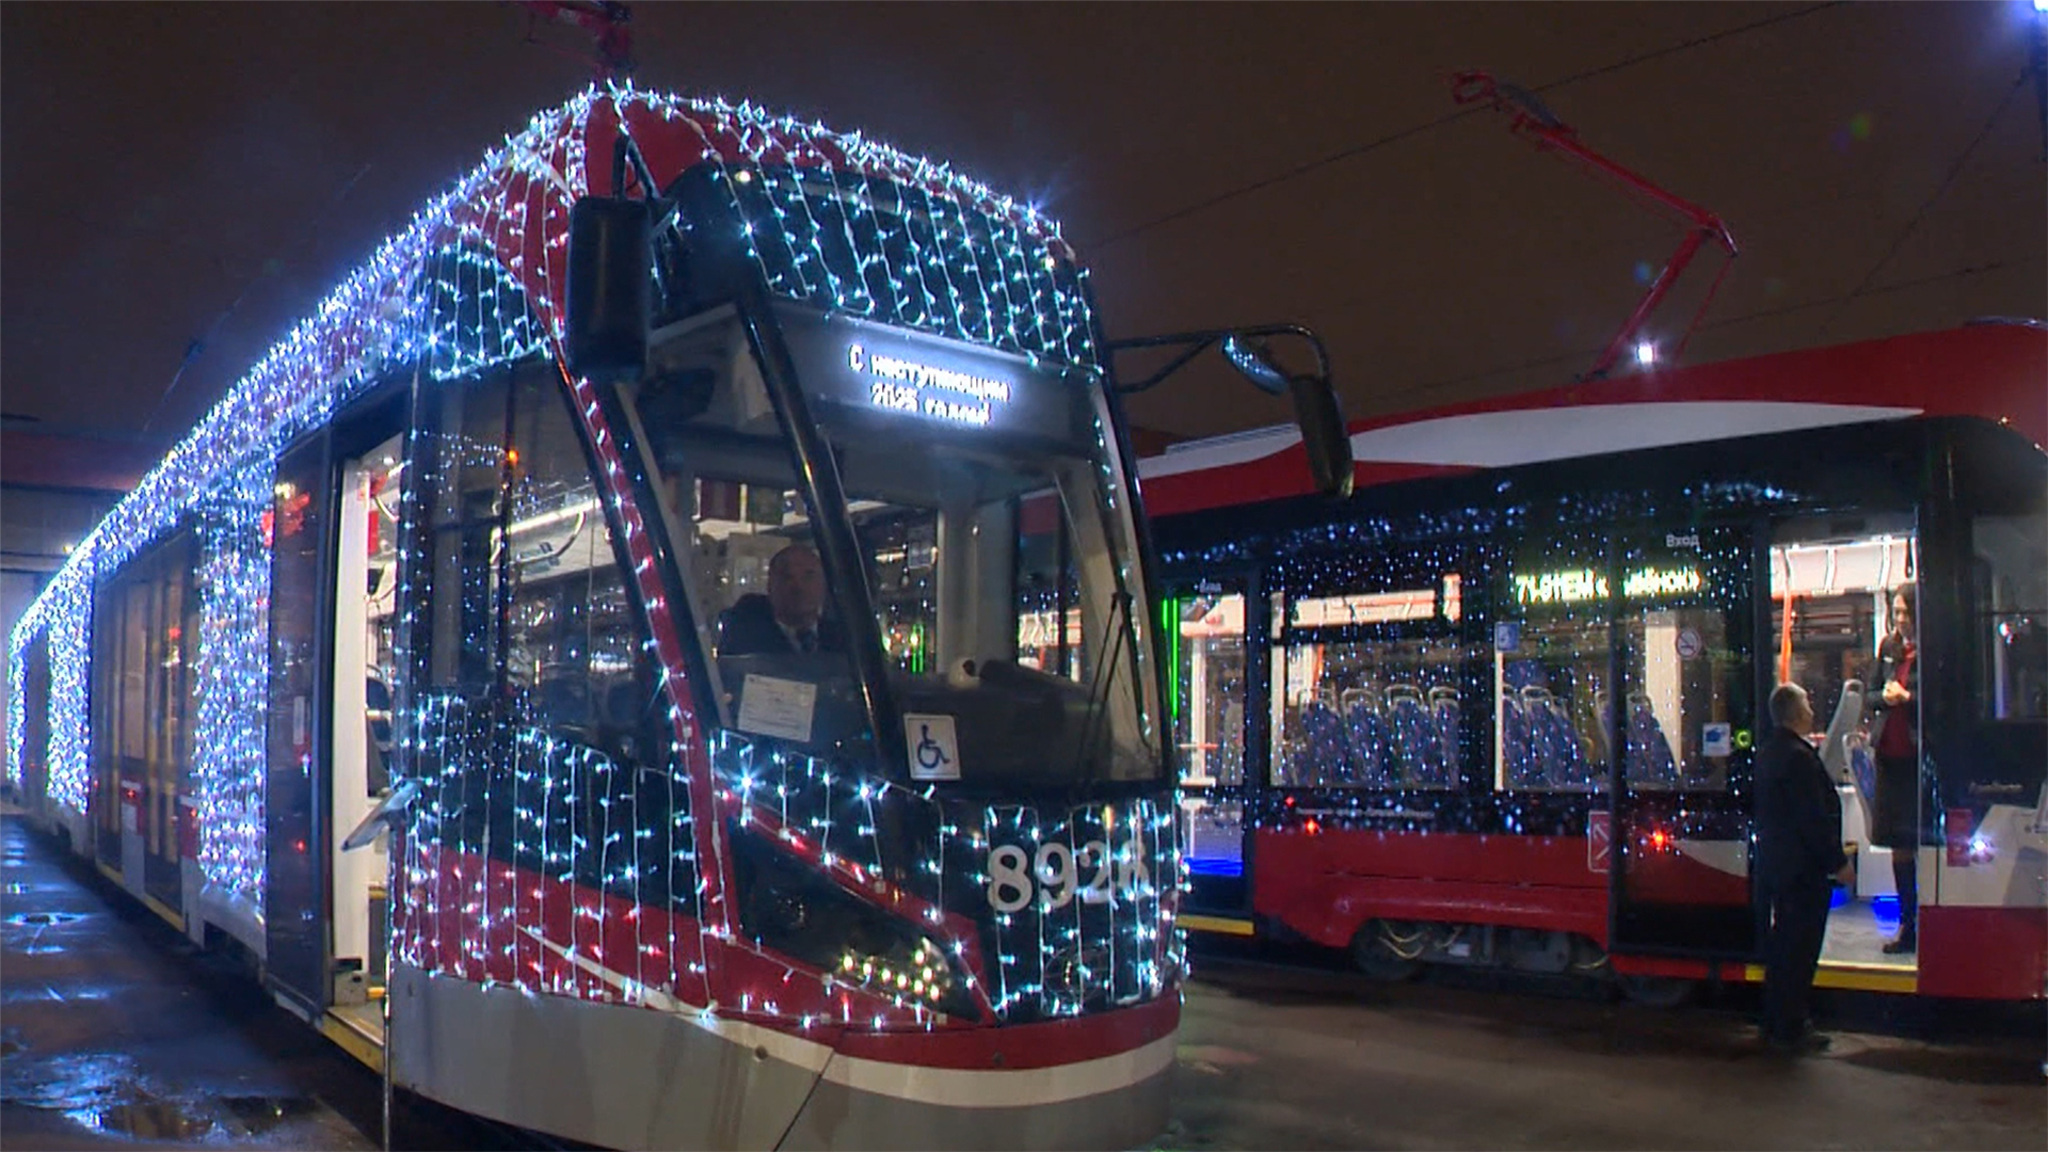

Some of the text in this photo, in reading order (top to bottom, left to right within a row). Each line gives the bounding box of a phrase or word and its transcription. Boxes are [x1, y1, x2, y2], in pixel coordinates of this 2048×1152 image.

[849, 344, 865, 371] С
[871, 382, 919, 412] 2025
[1666, 534, 1700, 547] Вход
